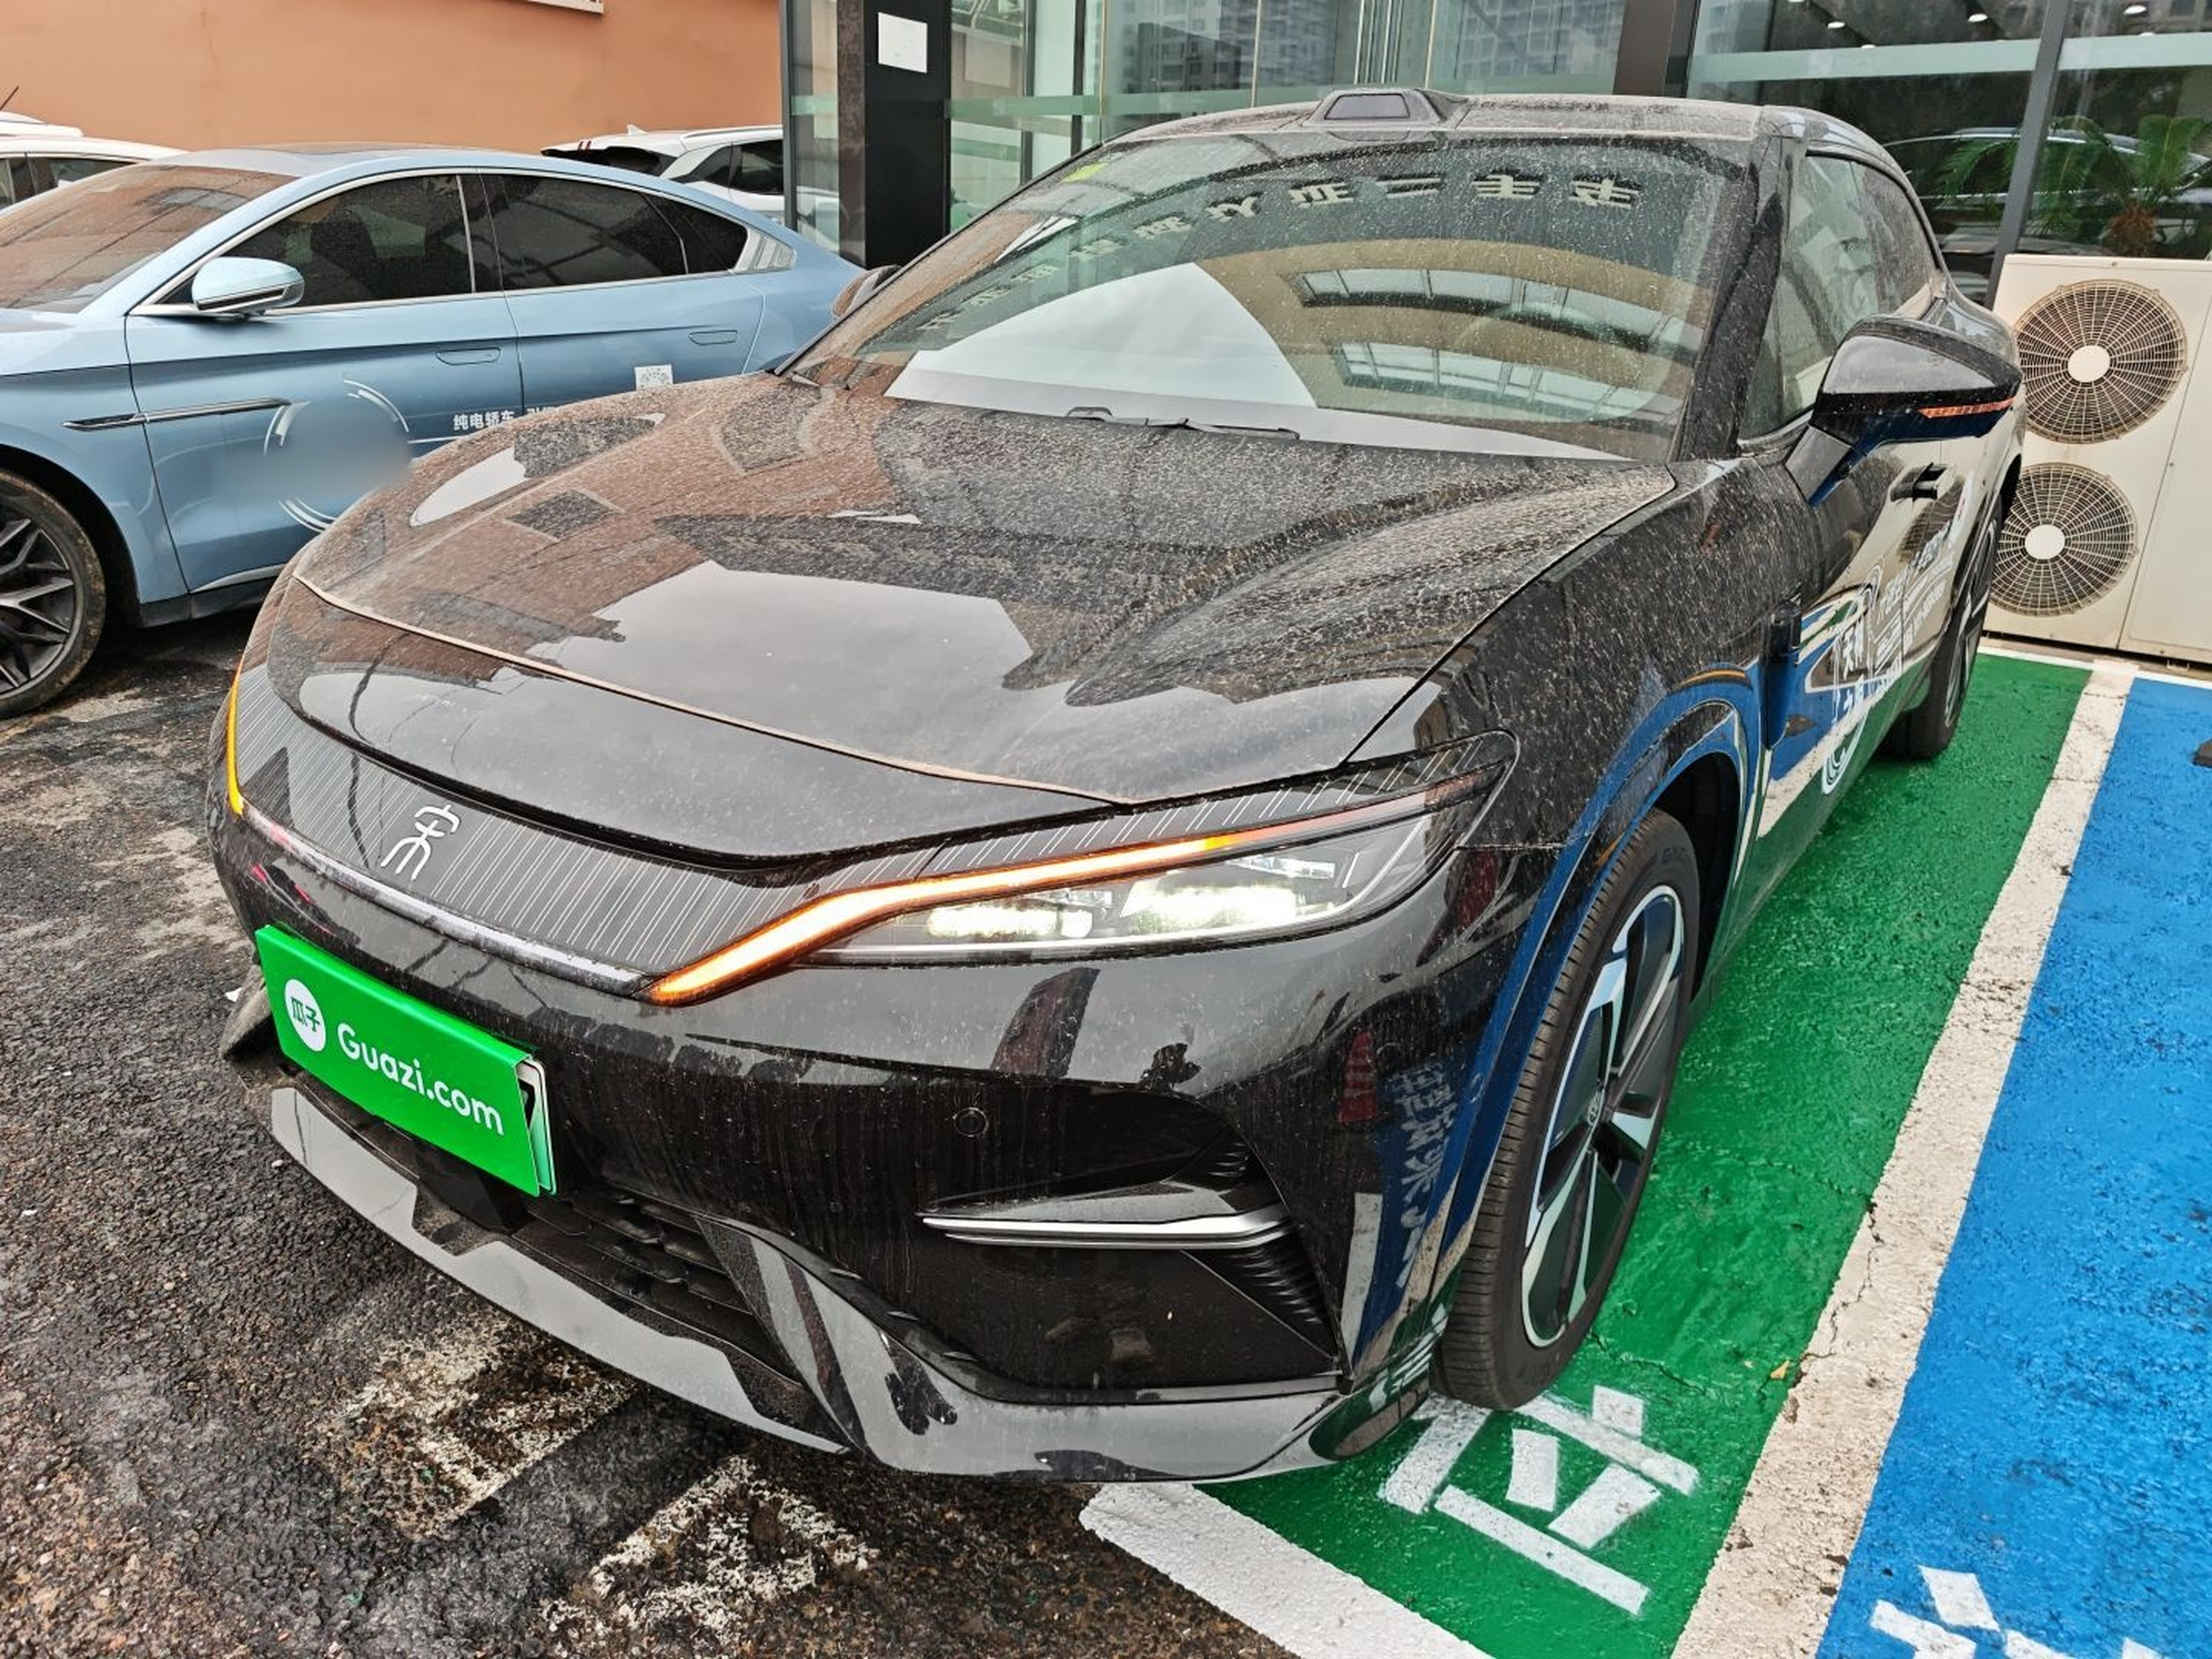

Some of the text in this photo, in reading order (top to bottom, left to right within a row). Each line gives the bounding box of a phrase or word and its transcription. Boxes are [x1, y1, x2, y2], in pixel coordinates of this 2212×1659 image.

[453, 410, 515, 431] 纯电轿车
[290, 997, 320, 1032] 瓜子
[338, 1023, 504, 1135] Guazi.com
